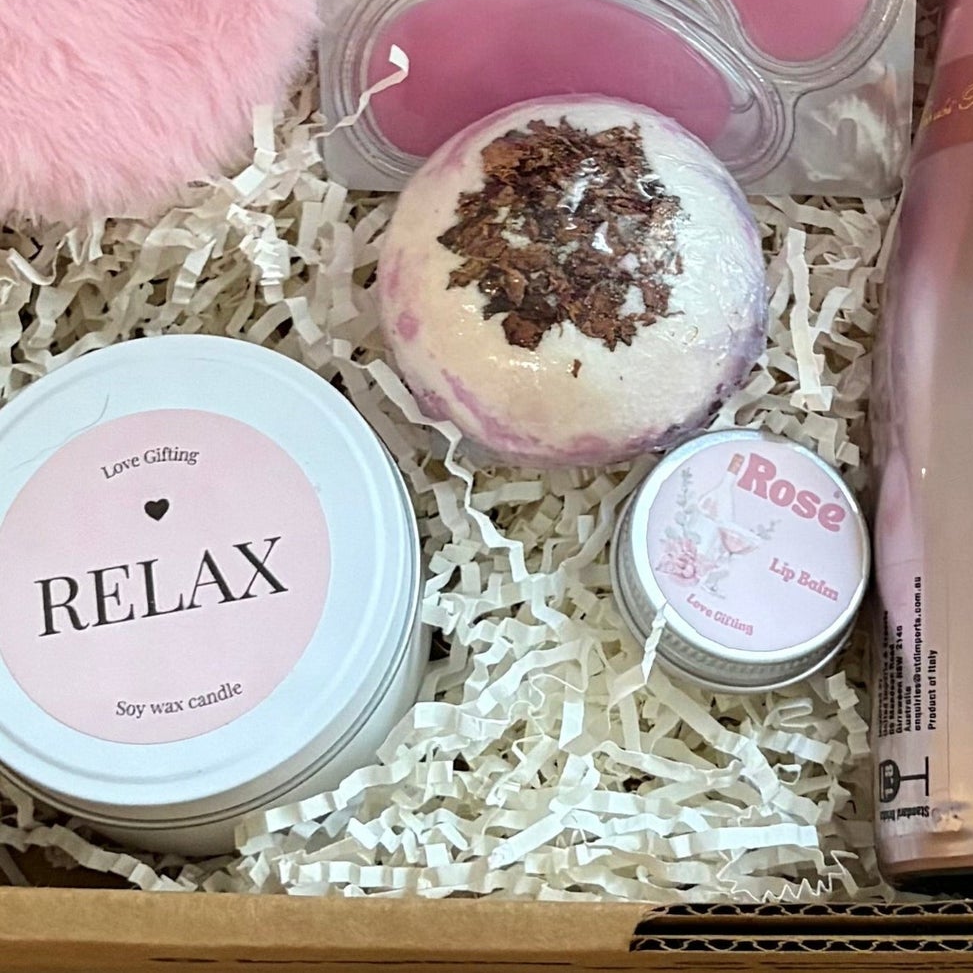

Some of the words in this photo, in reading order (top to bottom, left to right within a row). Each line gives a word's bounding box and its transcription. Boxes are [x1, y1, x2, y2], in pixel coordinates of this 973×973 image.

[101, 455, 140, 479] Love
[143, 446, 199, 465] Gifting
[34, 536, 289, 638] RELAX
[769, 557, 795, 582] Lip
[797, 571, 840, 601] Balm
[686, 593, 713, 618] Love
[713, 610, 754, 636] Gifting
[928, 650, 937, 673] Italy
[928, 676, 936, 686] of
[115, 700, 146, 719] Soy
[150, 702, 184, 715] wax
[188, 682, 243, 708] candle
[928, 689, 936, 730] Product
